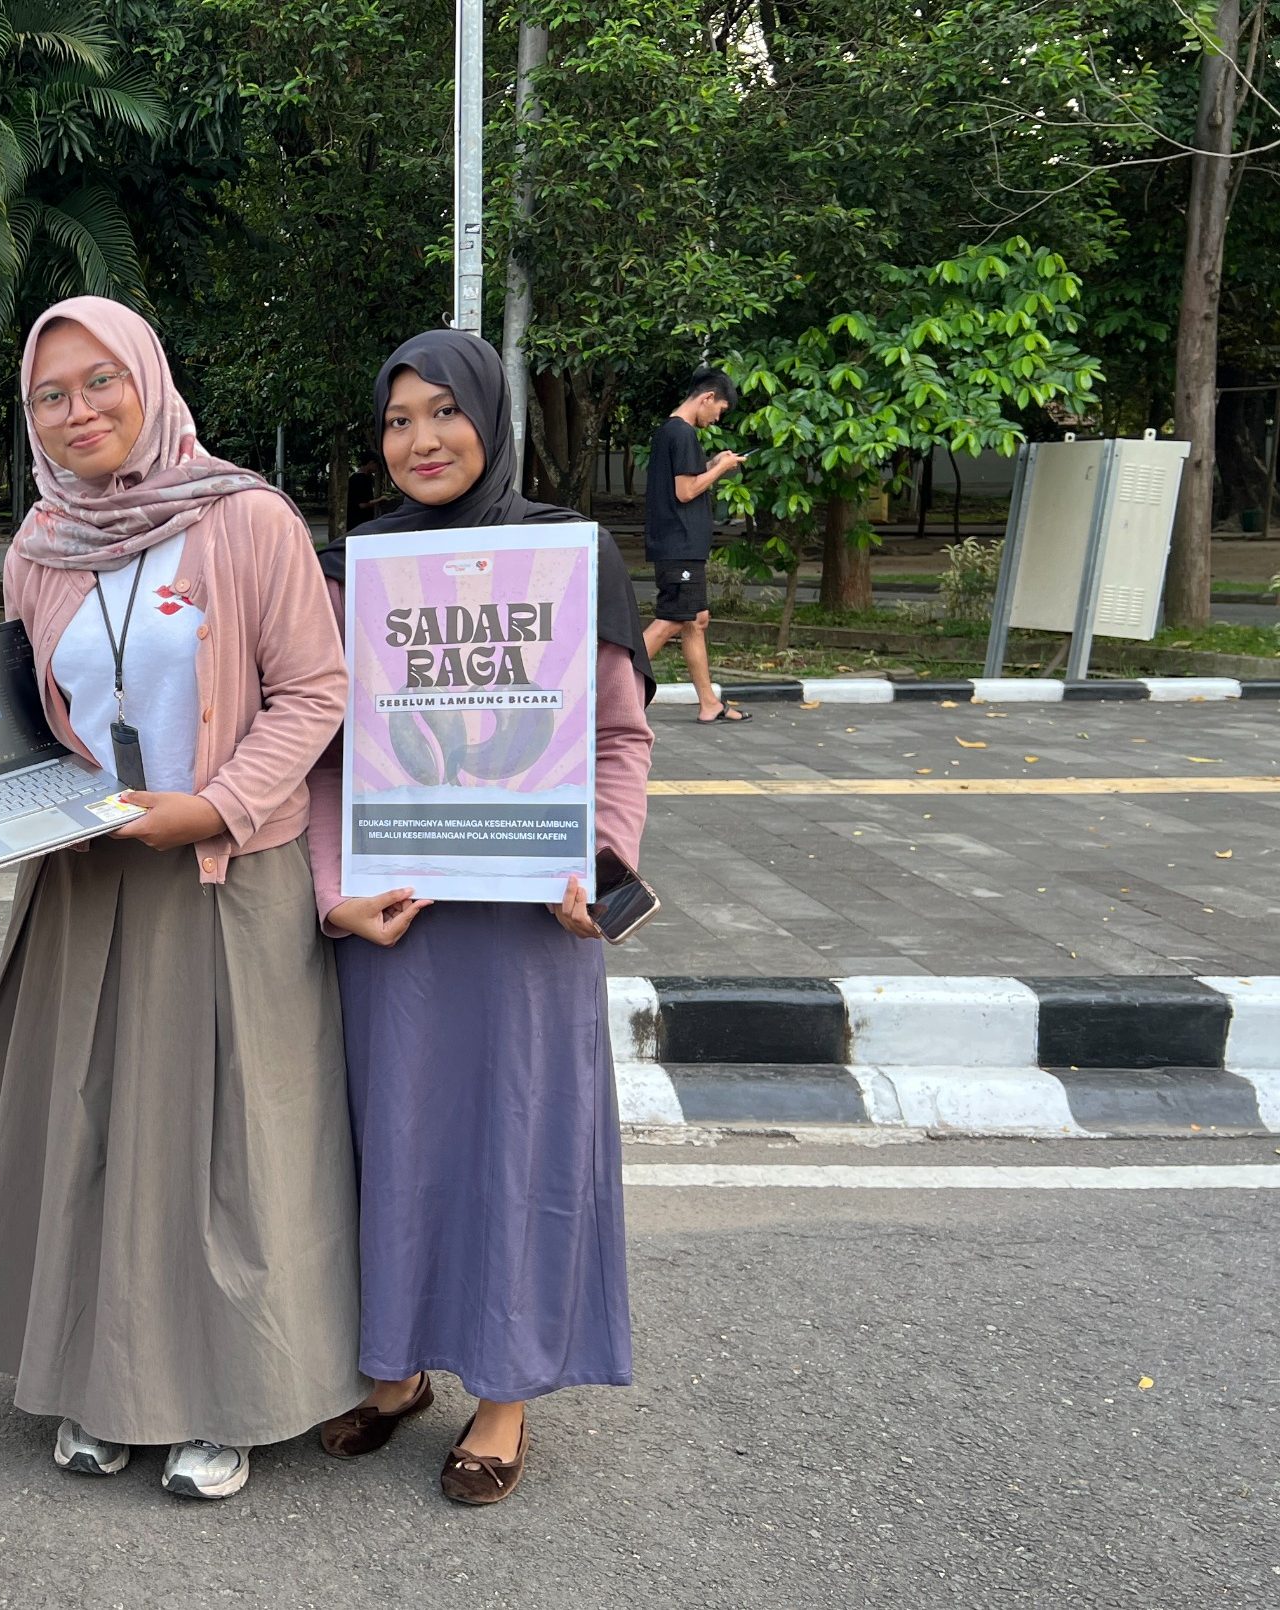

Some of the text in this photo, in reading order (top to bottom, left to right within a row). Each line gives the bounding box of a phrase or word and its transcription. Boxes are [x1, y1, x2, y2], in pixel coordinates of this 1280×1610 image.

[385, 602, 554, 648] SADARI
[406, 646, 531, 689] RAGA
[379, 695, 558, 707] SEBELUM LAMBUNG BICARA
[358, 819, 579, 829] EDUKASI PENTINGNYA MENJAGA KESEHATAN LAMBUNG
[368, 831, 567, 841] MELALUI KESEIMBANGAN POLA KONSUMSI KAFEIN
